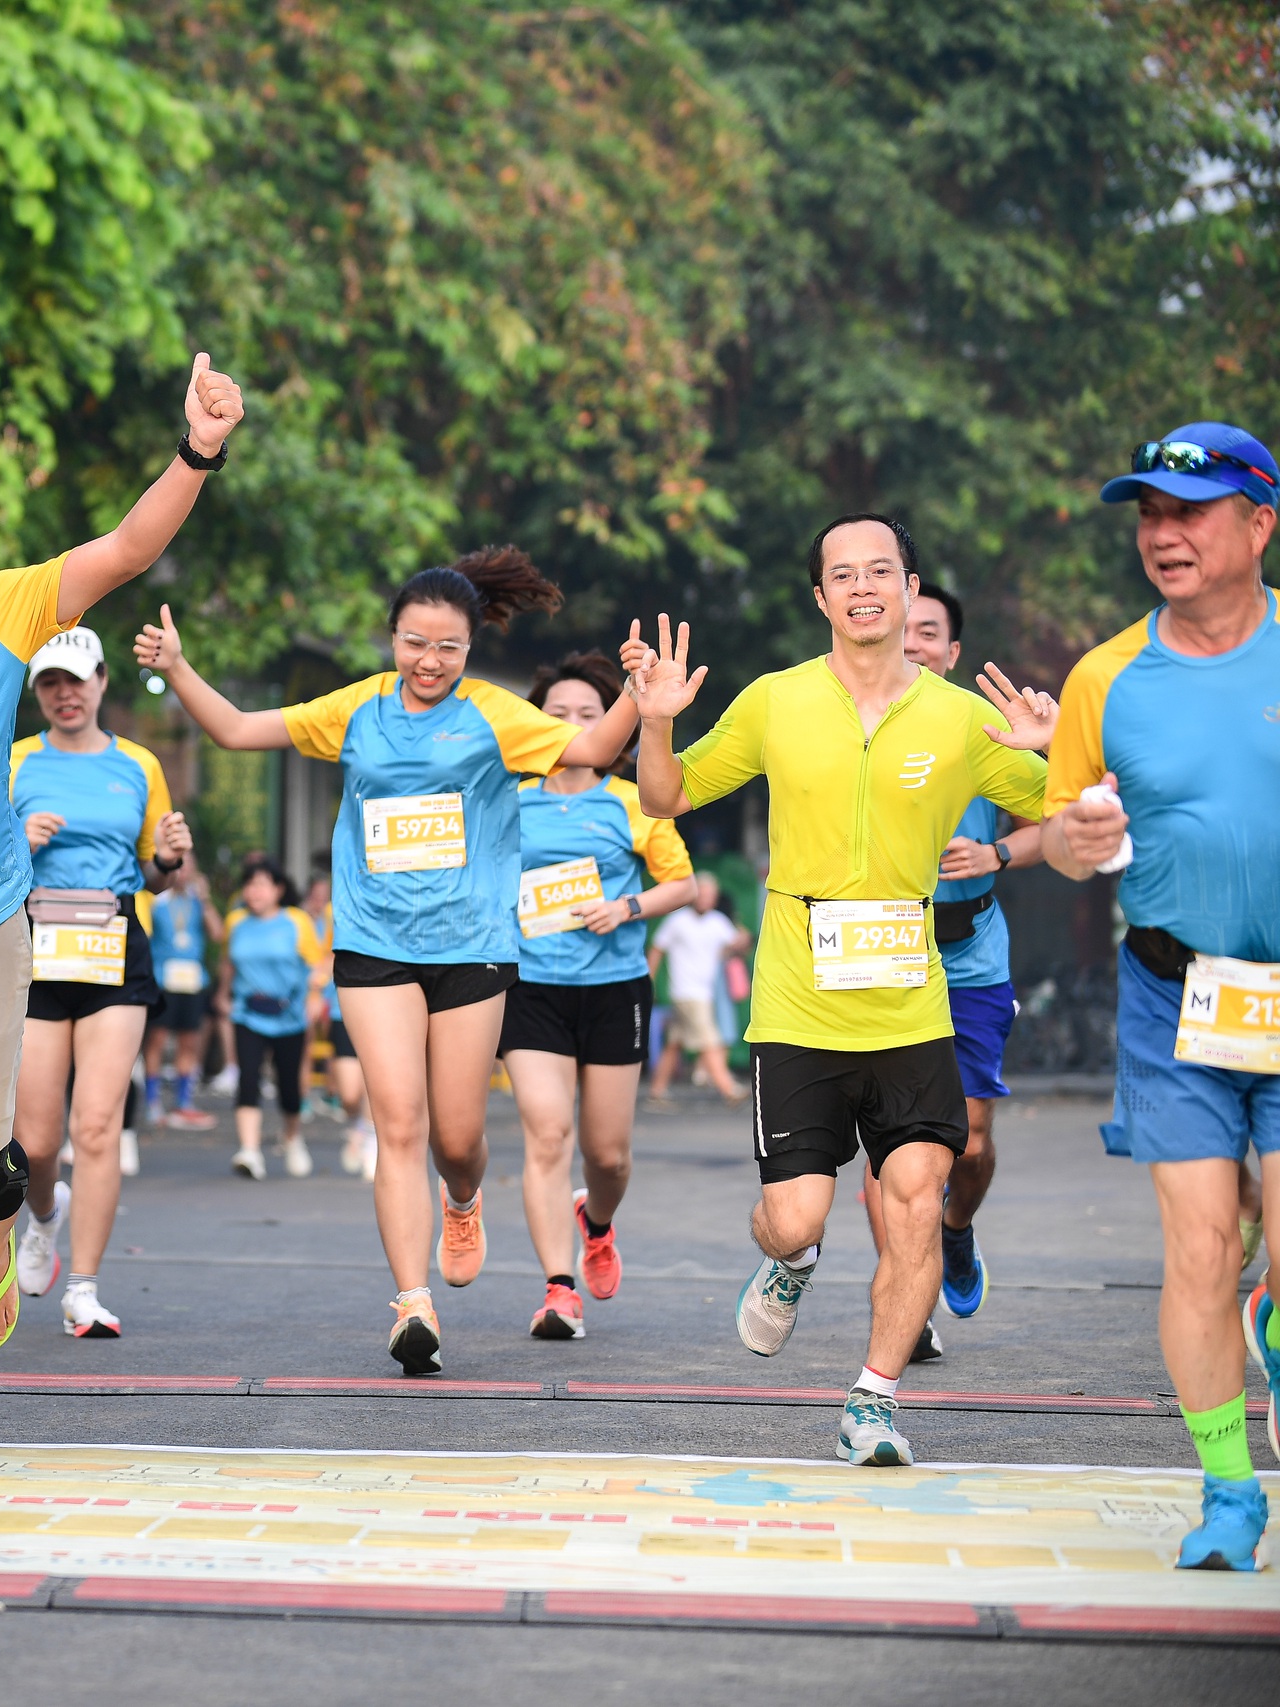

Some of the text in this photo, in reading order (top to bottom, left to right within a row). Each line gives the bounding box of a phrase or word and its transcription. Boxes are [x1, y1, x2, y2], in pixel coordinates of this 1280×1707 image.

[373, 816, 460, 839] F 59734
[540, 877, 598, 907] 56846
[76, 934, 122, 955] 11215
[818, 926, 922, 949] M 29347
[1191, 989, 1211, 1012] M
